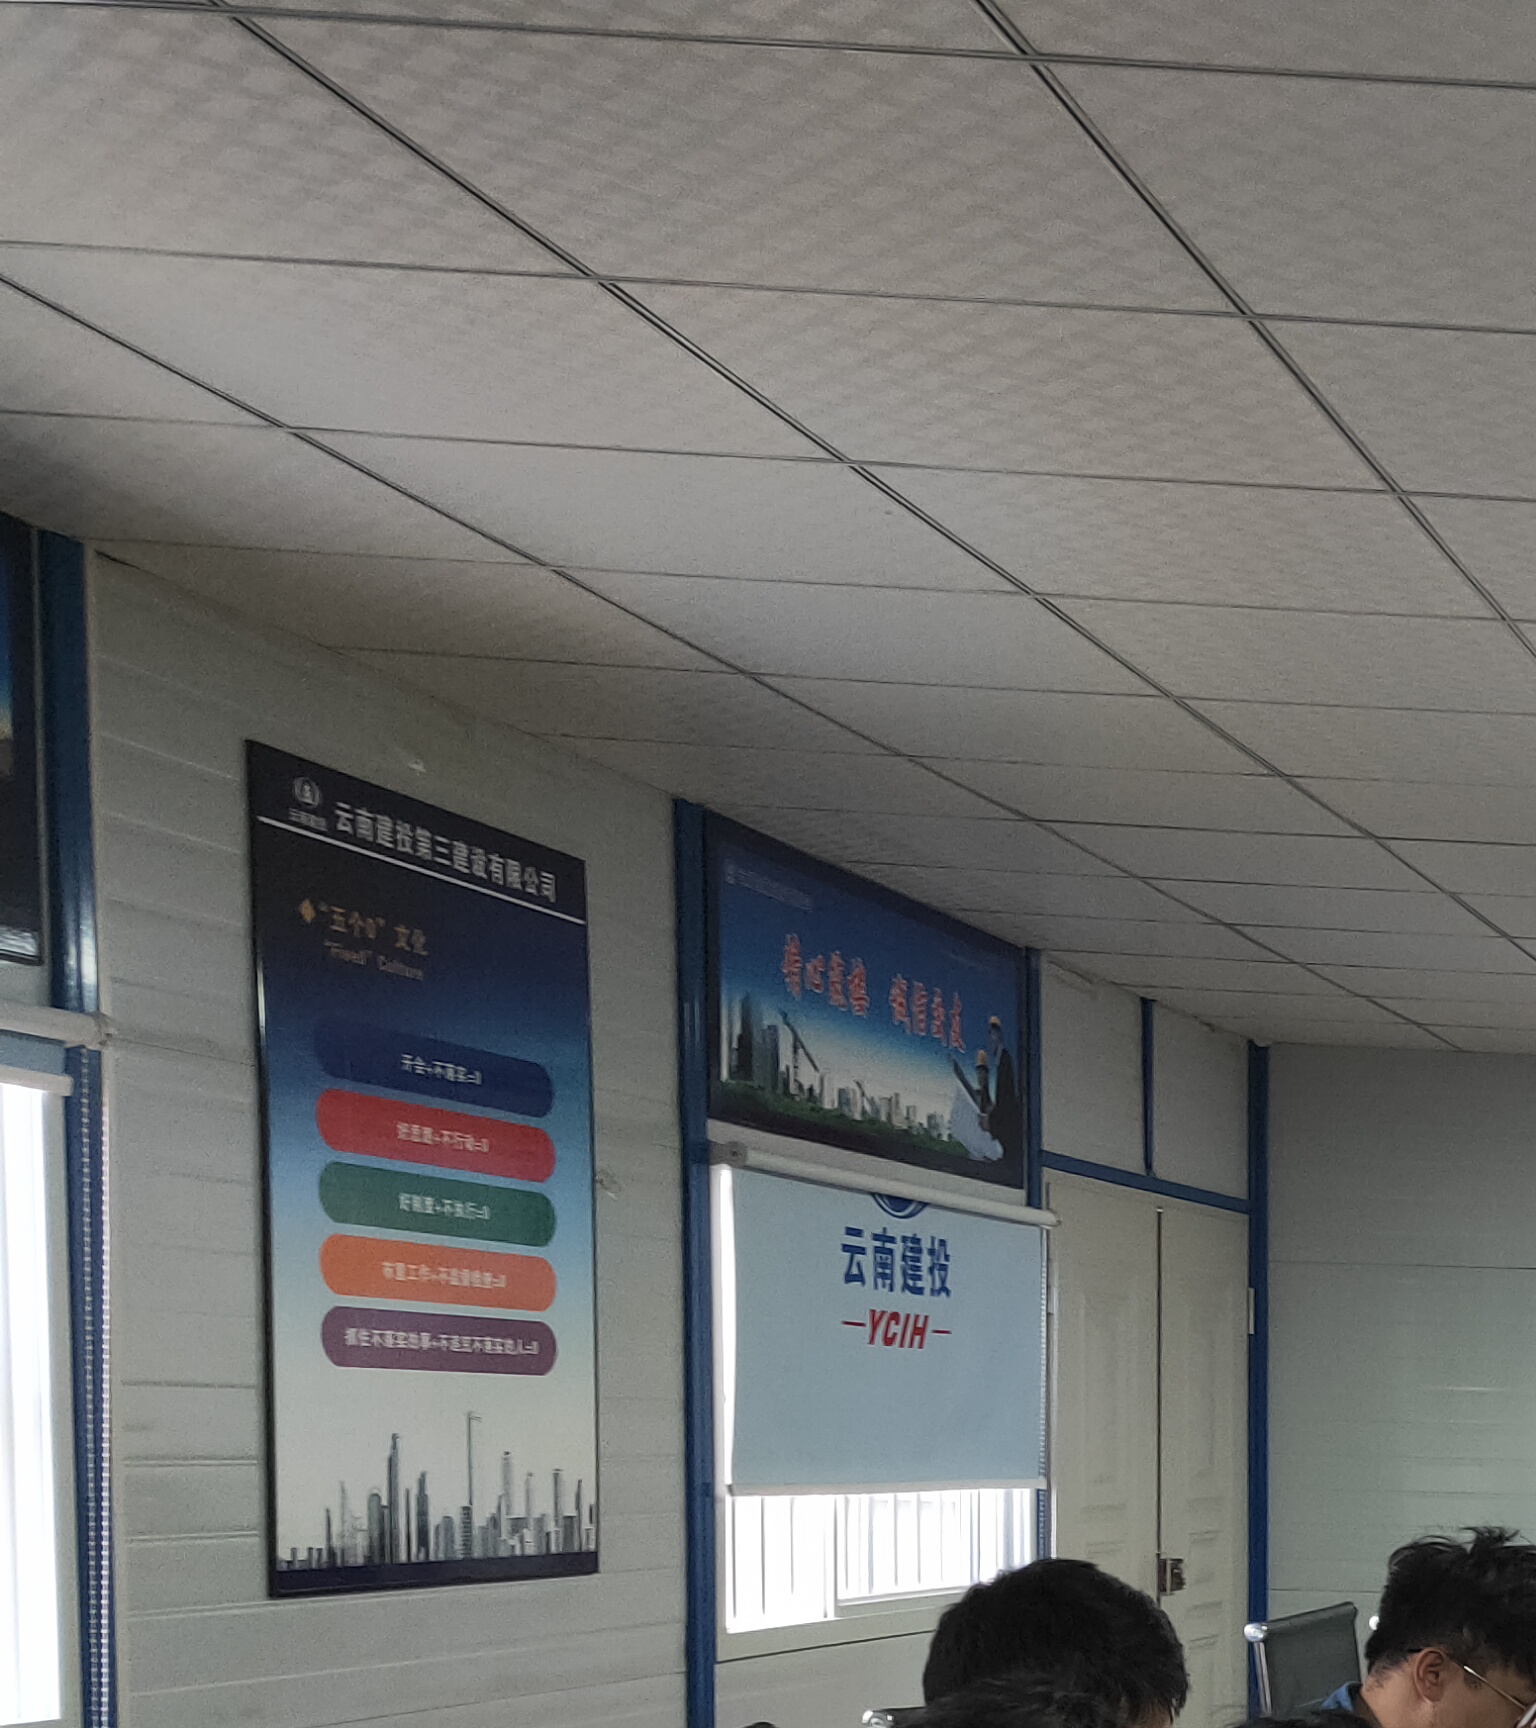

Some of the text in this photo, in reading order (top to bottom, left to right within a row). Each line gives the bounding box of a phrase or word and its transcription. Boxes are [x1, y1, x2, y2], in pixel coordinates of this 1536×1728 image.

[840, 1226, 952, 1298] 云南建投
[867, 1308, 930, 1350] YCIH
